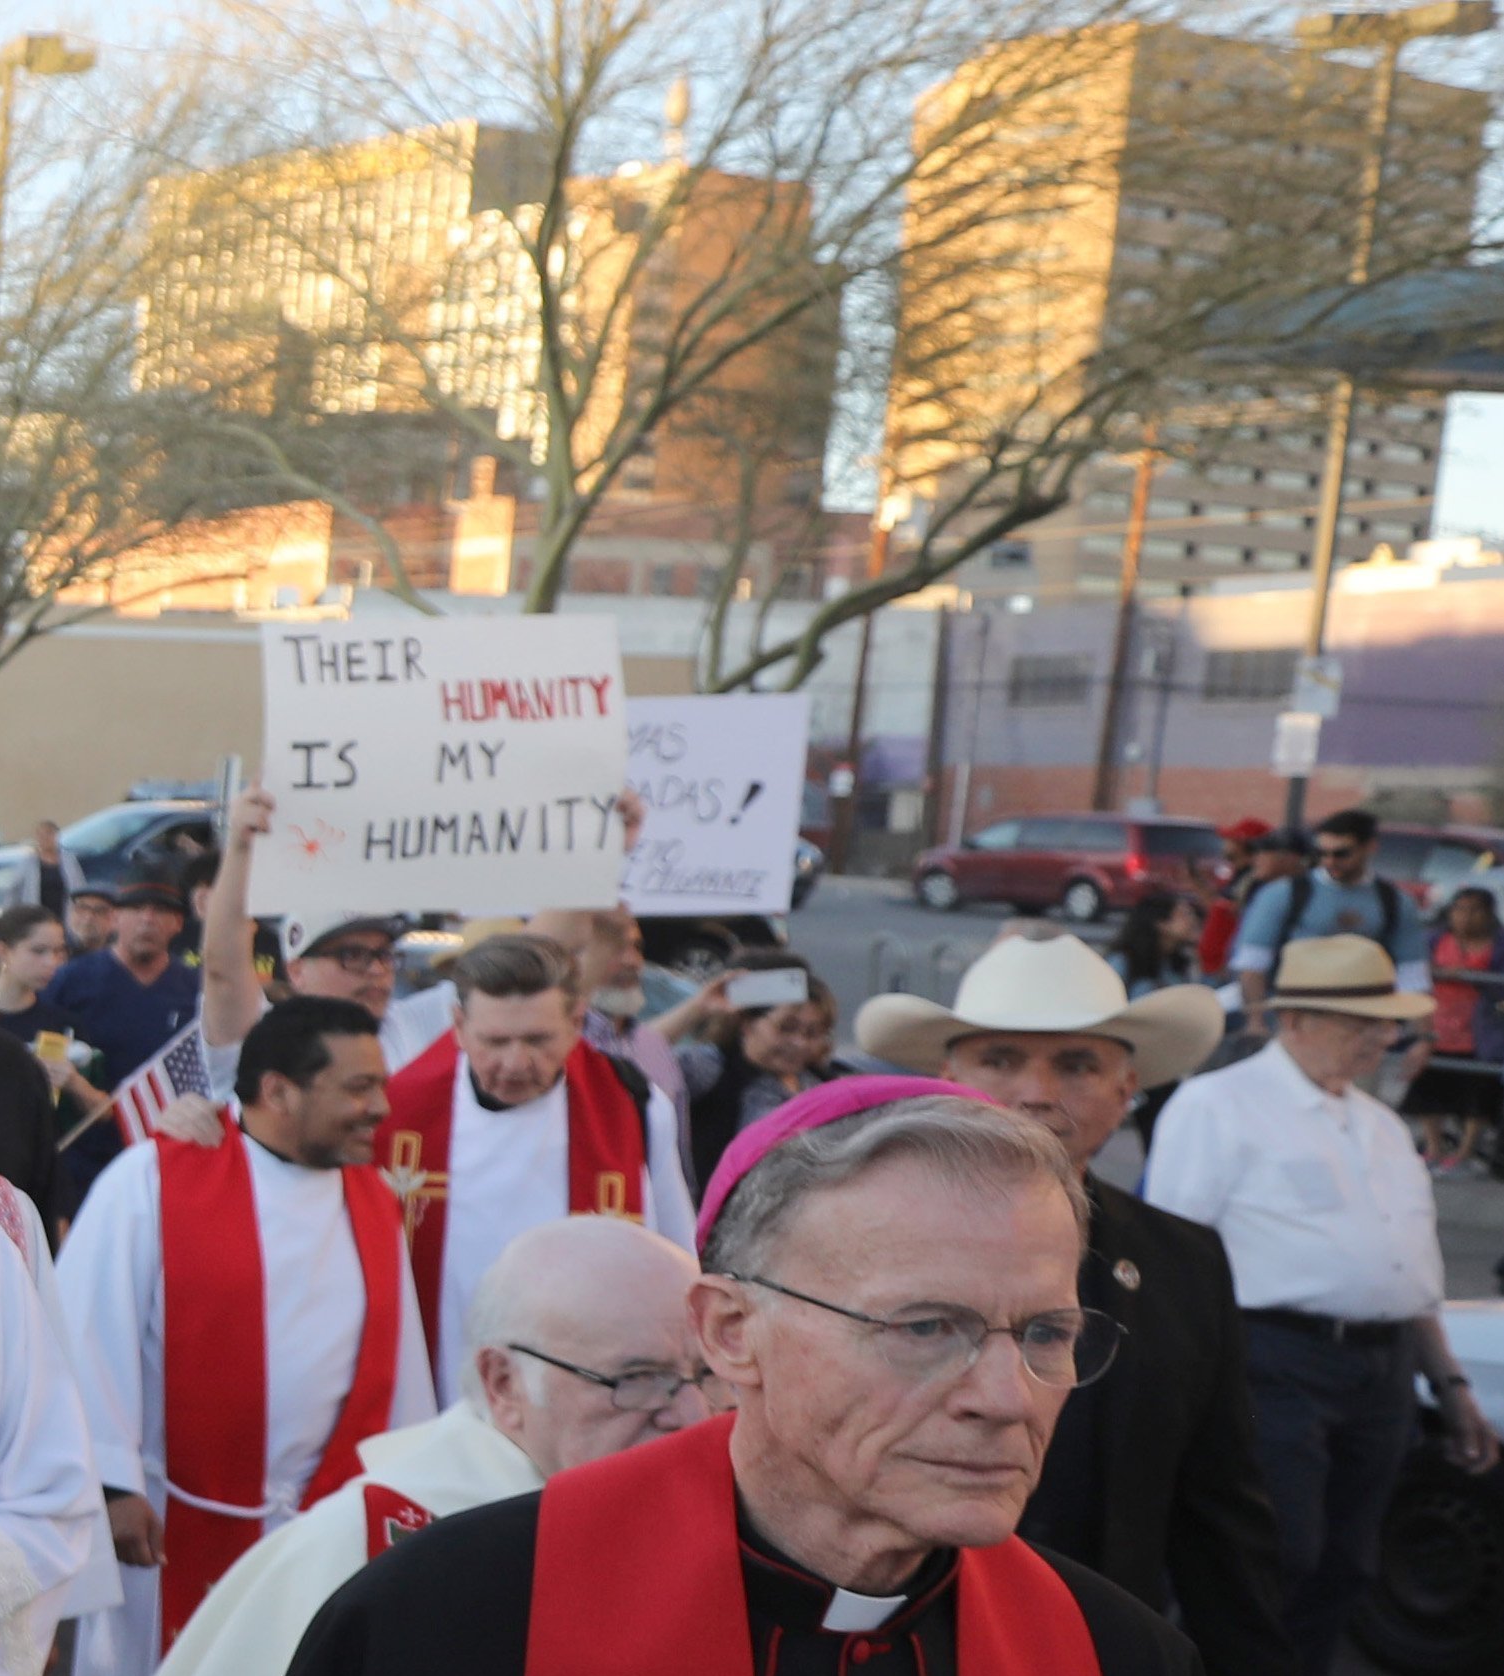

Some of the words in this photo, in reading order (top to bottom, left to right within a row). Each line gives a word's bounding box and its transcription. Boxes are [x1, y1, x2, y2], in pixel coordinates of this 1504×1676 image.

[283, 633, 427, 684] THEIR
[441, 674, 613, 722] HUMANITY
[292, 740, 358, 790] IS
[437, 740, 505, 784] MY
[364, 793, 618, 864] HUMANITY
